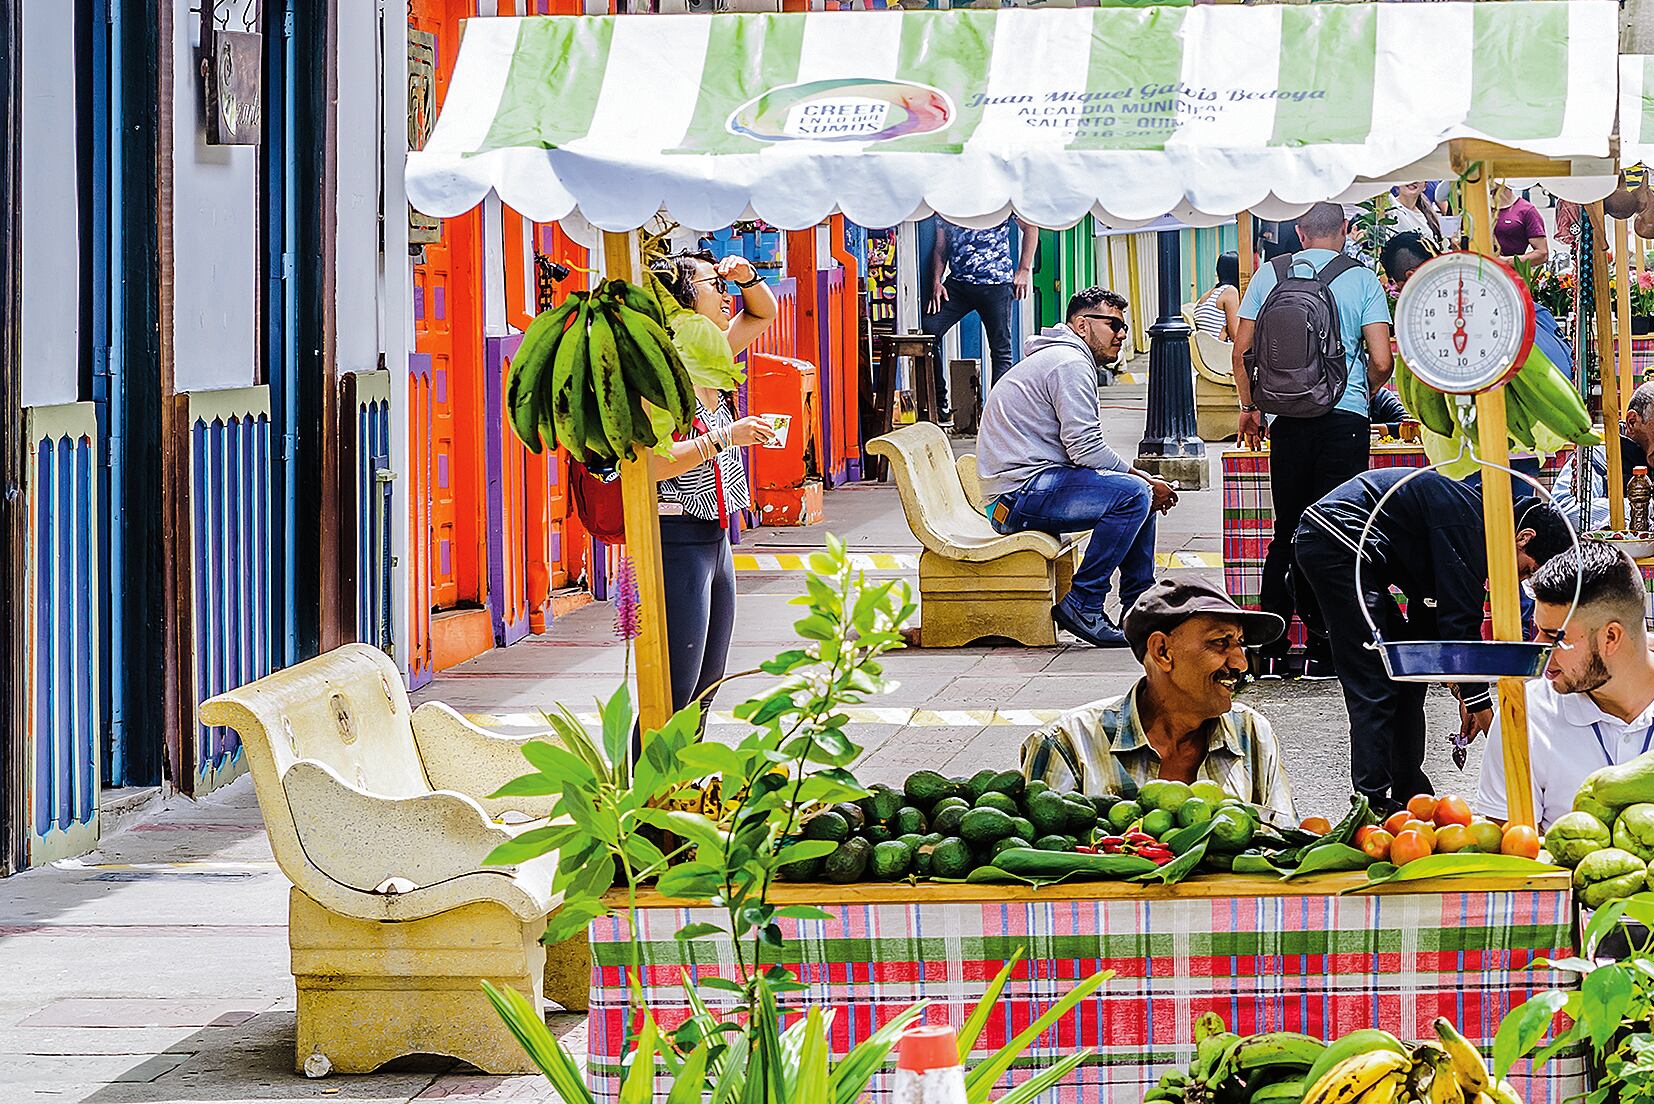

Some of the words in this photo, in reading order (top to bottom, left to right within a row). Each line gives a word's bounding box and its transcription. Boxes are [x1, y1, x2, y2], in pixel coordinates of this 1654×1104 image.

[965, 92, 1033, 107] Juan
[1044, 86, 1132, 104] Miguel
[803, 103, 886, 117] CREER
[1017, 104, 1117, 117] ALCALDIA
[1025, 115, 1117, 128] SALENTO
[1136, 115, 1216, 128] QUINO
[1437, 289, 1449, 298] 18
[1480, 288, 1487, 297] 2
[1425, 308, 1436, 317] 16
[1493, 307, 1499, 316] 4
[1426, 331, 1436, 341] 14
[1492, 330, 1499, 339] 6
[1438, 348, 1449, 358] 12
[1479, 348, 1486, 358] 8
[1457, 357, 1469, 367] 10
